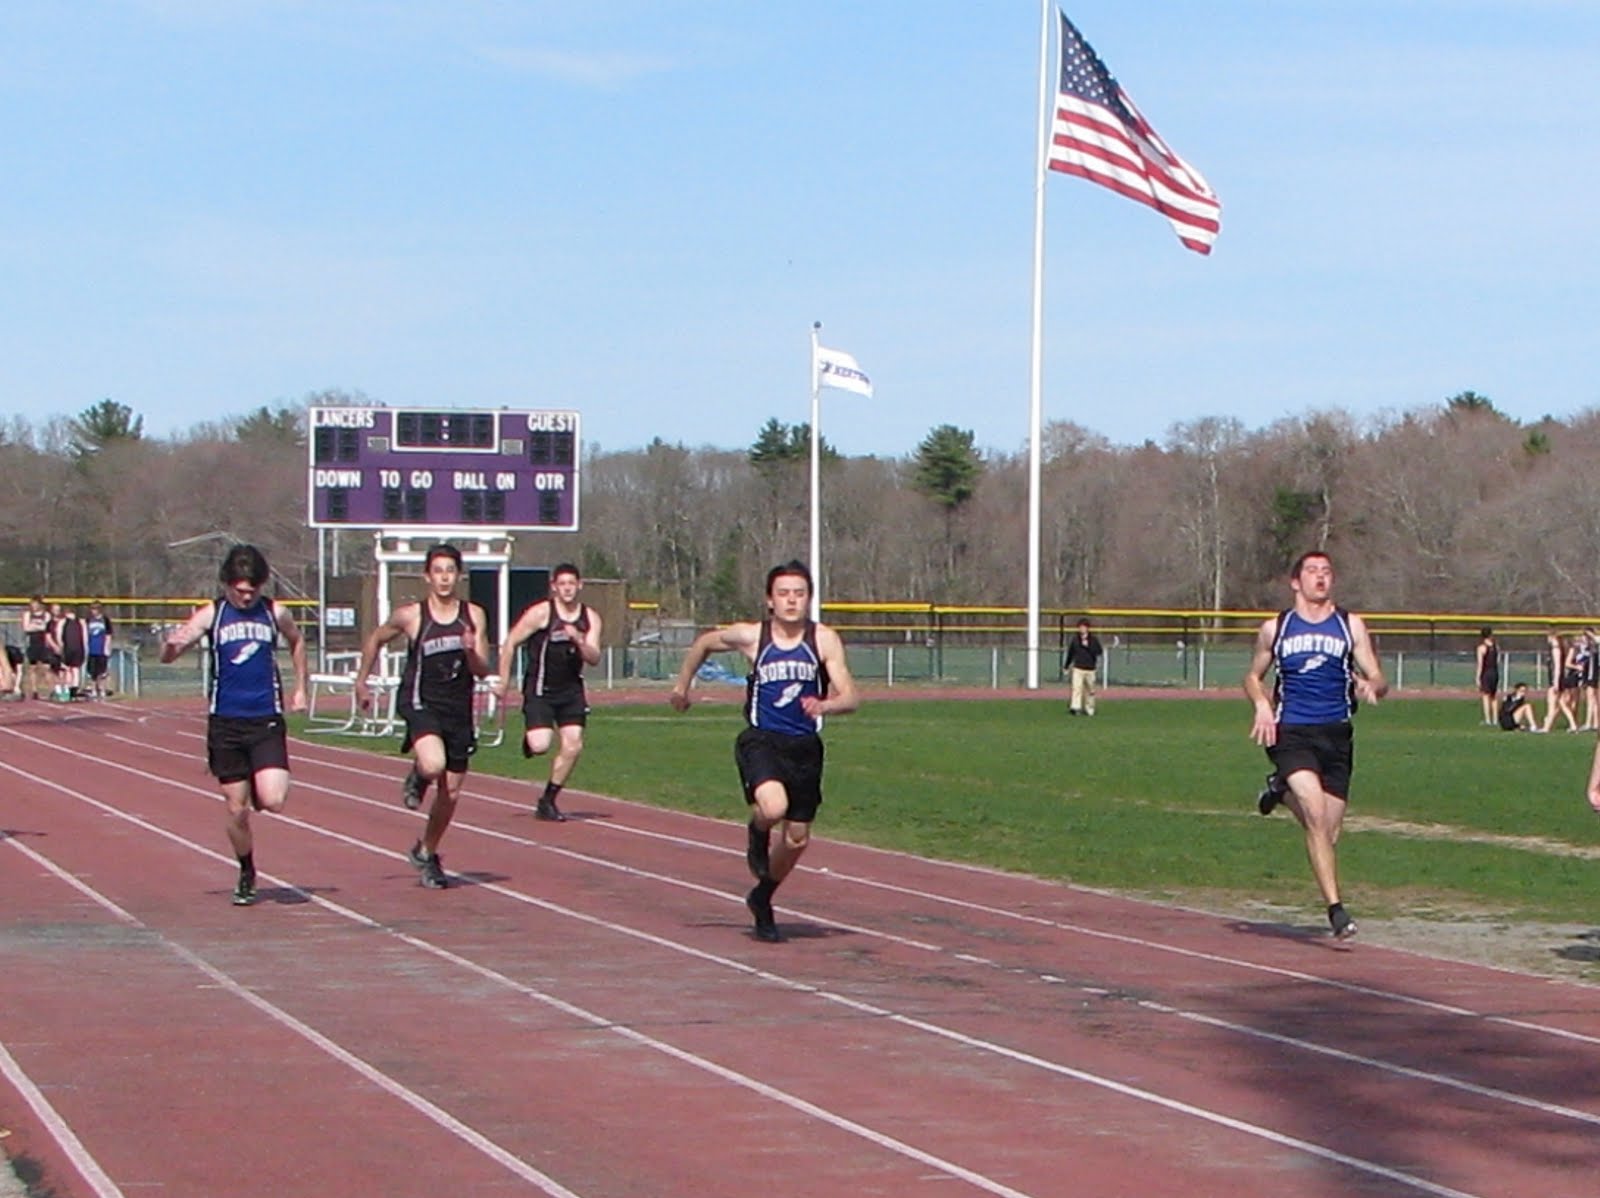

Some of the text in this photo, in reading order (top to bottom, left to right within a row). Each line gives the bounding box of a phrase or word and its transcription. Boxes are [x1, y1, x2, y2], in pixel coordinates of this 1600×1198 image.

[315, 410, 375, 428] LANCERS
[528, 412, 575, 431] GUEST
[316, 470, 361, 487] DOWN
[380, 470, 433, 489] TO GO
[453, 471, 515, 490] BALL ON
[220, 621, 272, 645] NORTON
[1282, 633, 1346, 658] NORTON
[760, 661, 817, 684] NORTON
